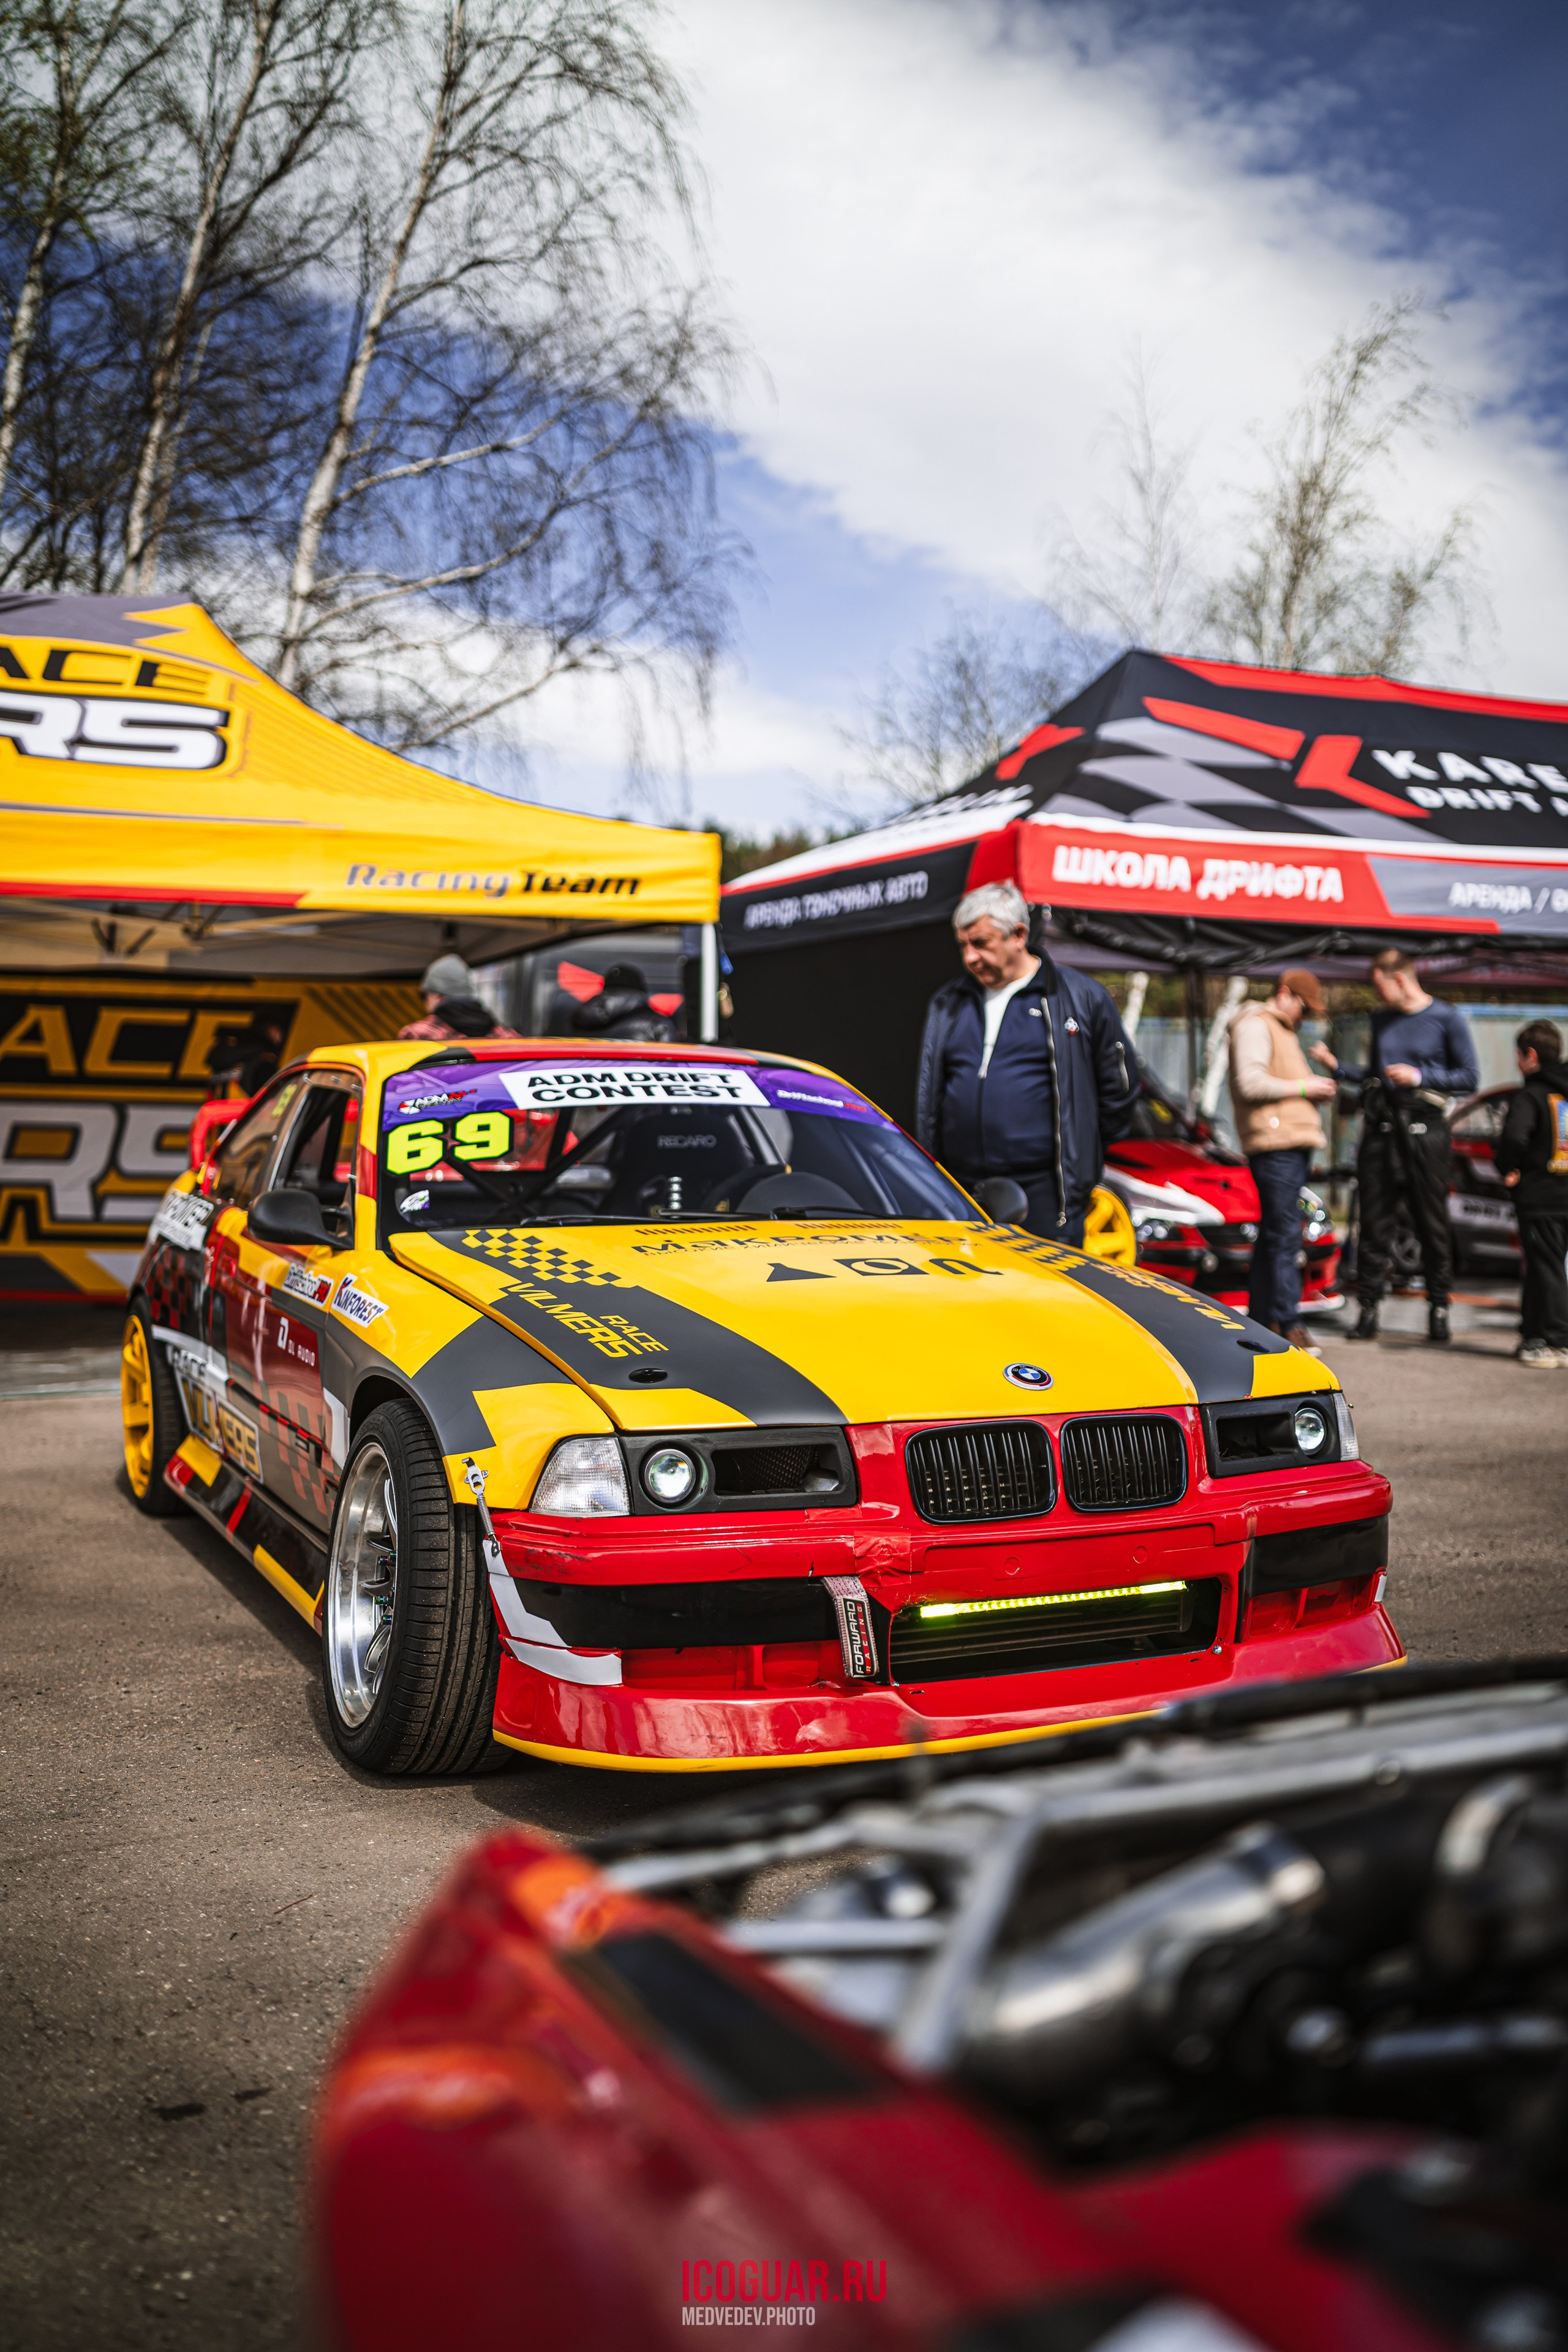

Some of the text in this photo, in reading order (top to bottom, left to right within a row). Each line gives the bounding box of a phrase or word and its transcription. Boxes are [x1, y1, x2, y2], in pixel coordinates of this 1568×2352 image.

[1404, 786, 1542, 813] DRIFT
[345, 864, 643, 899] Racing Team
[1051, 845, 1345, 903] ШКОЛА ДРИФТА
[1448, 881, 1533, 914] АРЕНДА
[528, 1071, 733, 1088] ADM DRIFT
[532, 1085, 742, 1102] CONTEST
[386, 1111, 511, 1175] 69
[657, 1134, 717, 1148] RECARO
[507, 1282, 644, 1358] VILMERS
[600, 1314, 669, 1352] RACE
[846, 1600, 864, 1675] FORWARD
[858, 1606, 872, 1672] RACING
